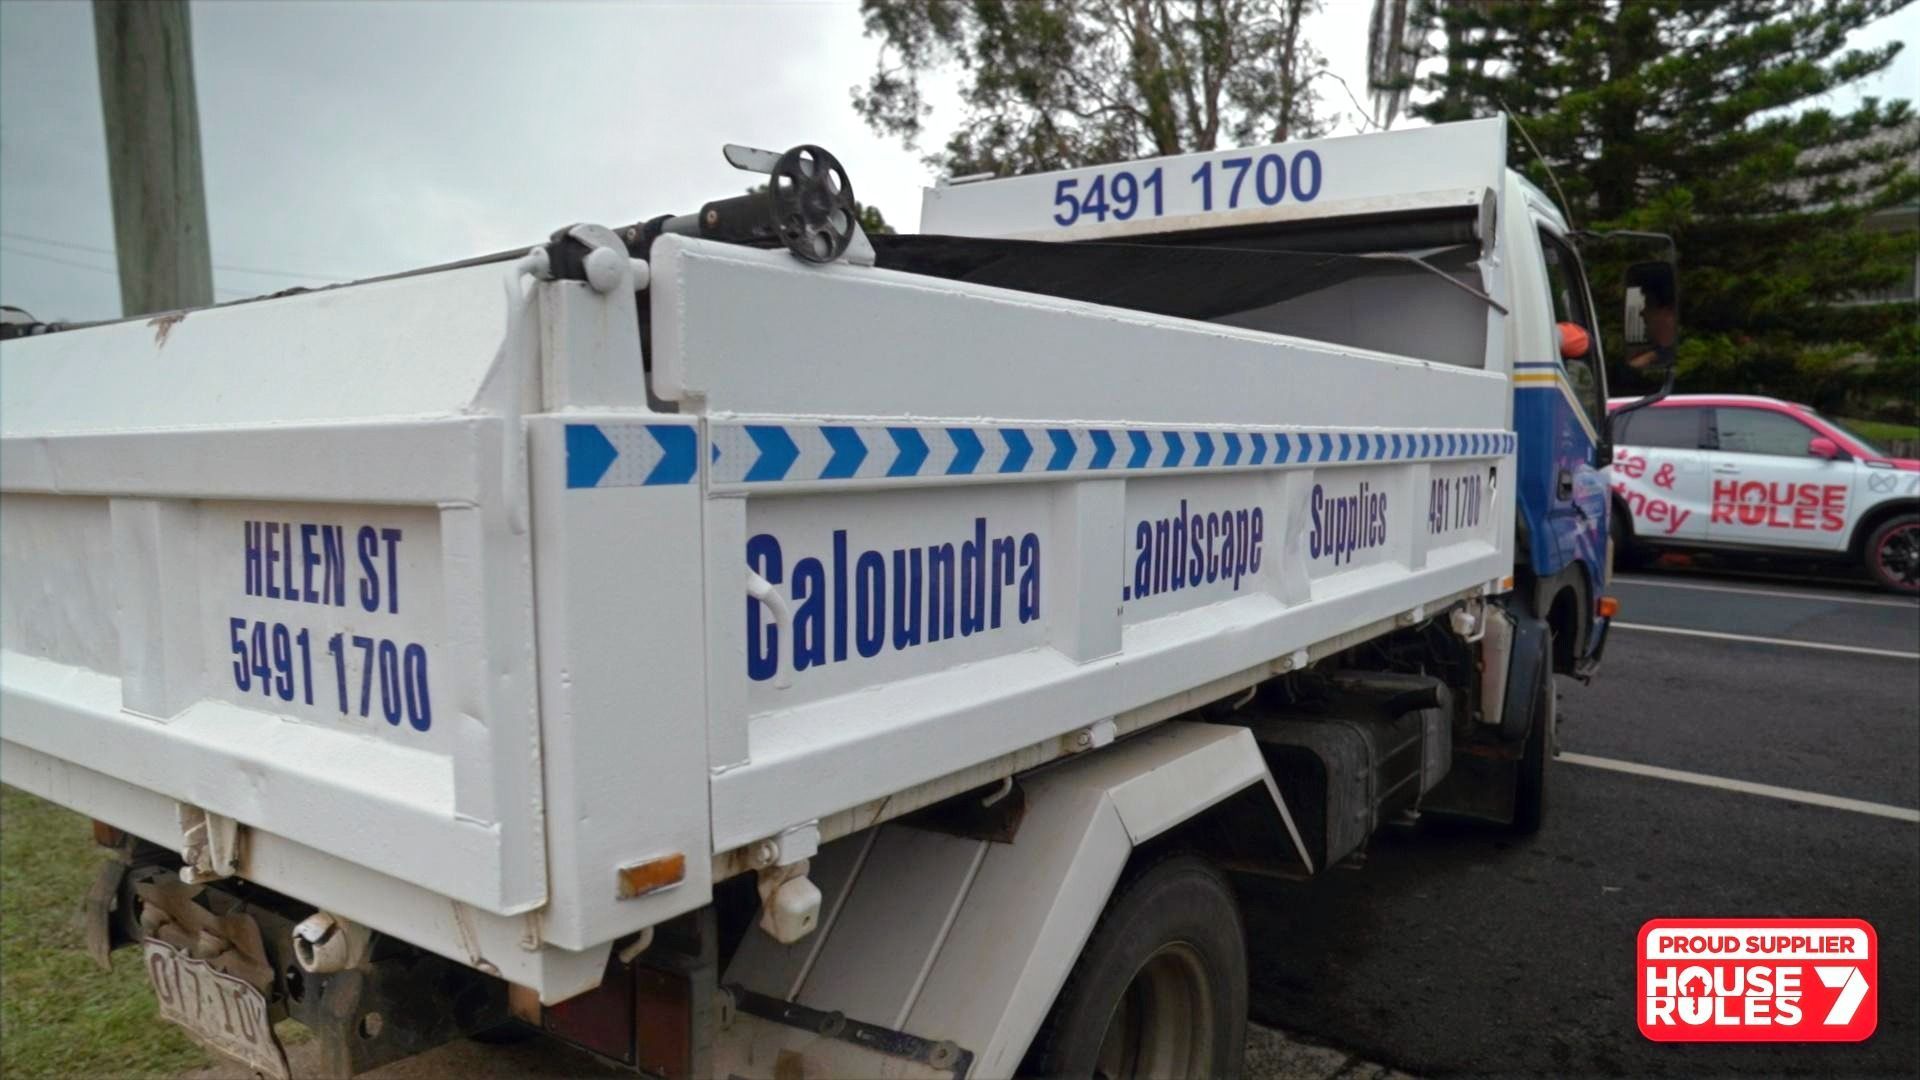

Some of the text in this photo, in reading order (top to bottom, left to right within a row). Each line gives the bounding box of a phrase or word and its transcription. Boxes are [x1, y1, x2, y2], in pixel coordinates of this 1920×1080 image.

[1053, 149, 1322, 227] 5491 1700
[1652, 462, 1676, 491] &
[1712, 479, 1848, 508] HOUSE
[1710, 502, 1846, 532] RULES
[244, 520, 405, 614] HELEN ST
[746, 517, 1040, 681] Caloundra
[1122, 499, 1263, 601] andscape
[1309, 481, 1387, 566] Supplies
[1455, 474, 1482, 529] 1700
[229, 616, 431, 732] 5491 1700
